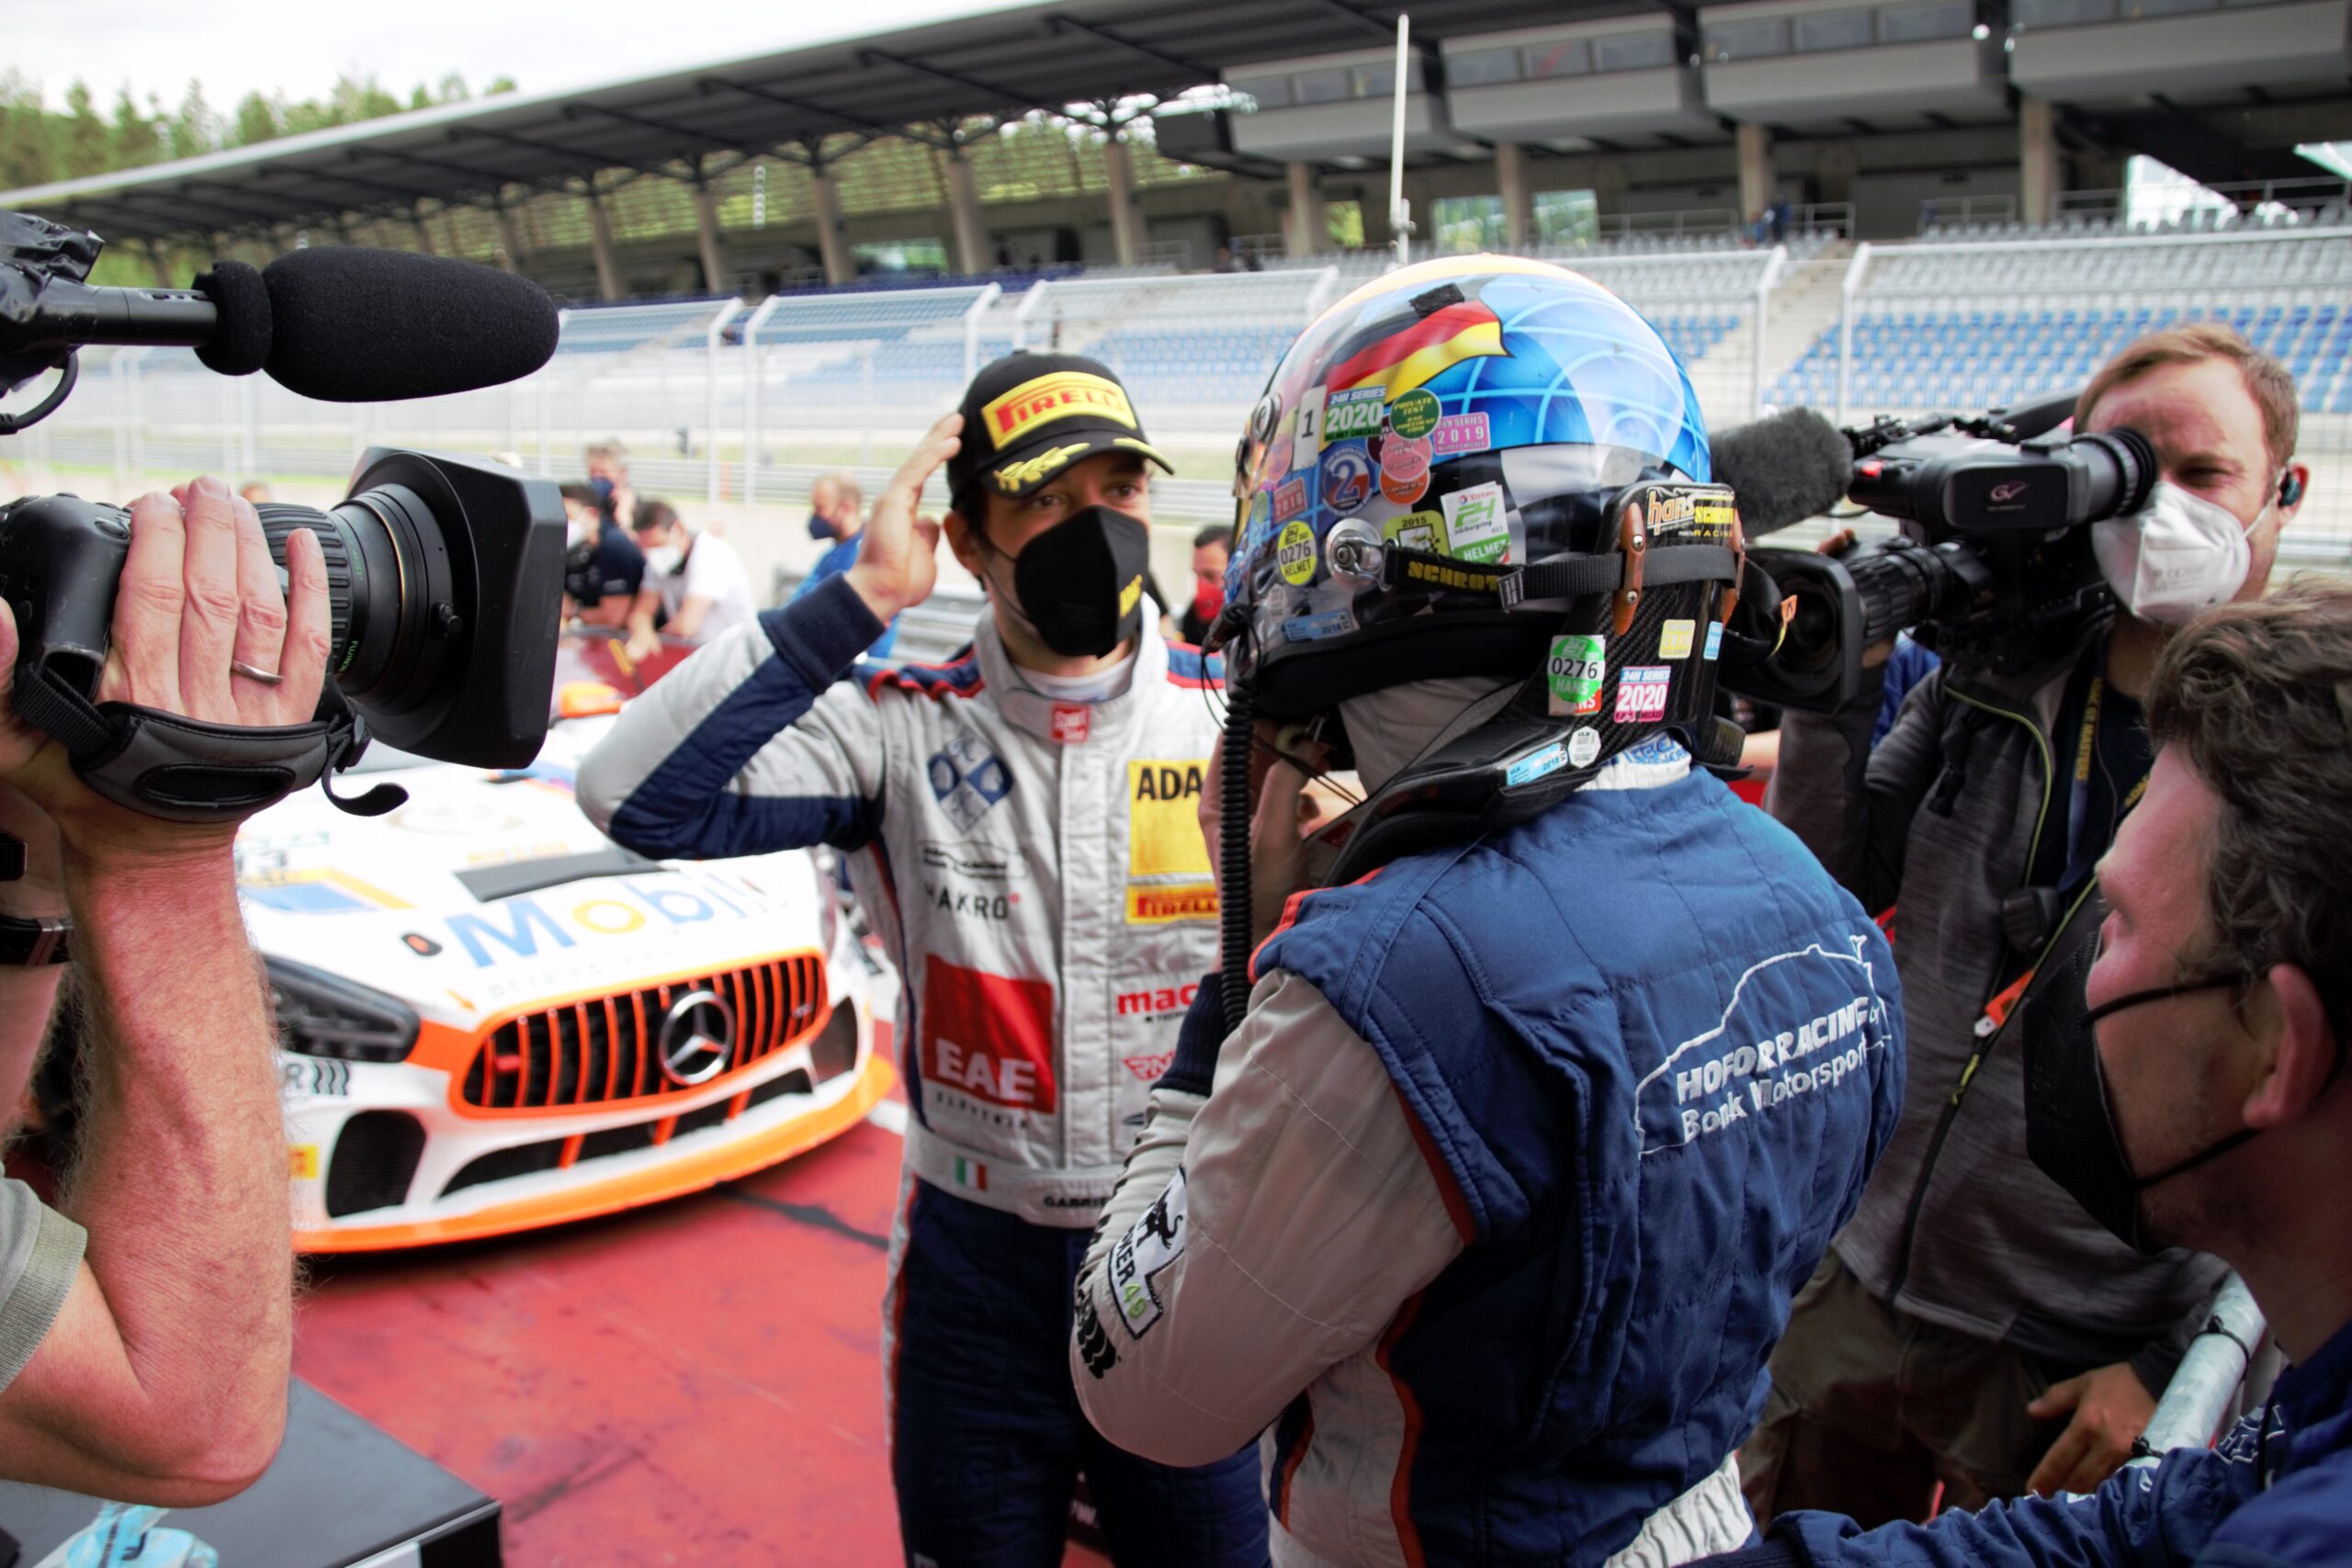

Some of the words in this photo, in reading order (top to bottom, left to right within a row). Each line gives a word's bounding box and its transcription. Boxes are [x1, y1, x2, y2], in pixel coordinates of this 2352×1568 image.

[1350, 387, 1386, 401] SERIES
[1394, 396, 1433, 411] PRIVATE
[1327, 401, 1384, 432] 2020
[1402, 405, 1425, 415] TEST
[1453, 415, 1484, 426] SERIES
[1301, 410, 1315, 439] 1
[1438, 425, 1485, 446] 2019
[1333, 458, 1360, 503] 2
[1401, 516, 1428, 527] 2015
[1647, 489, 1696, 536] hans
[1280, 541, 1312, 566] 0276
[1284, 559, 1312, 576] HELMET
[1551, 656, 1600, 680] 0276
[1643, 669, 1671, 682] SERIES
[1556, 677, 1589, 696] HANS
[1617, 683, 1668, 712] 2020
[935, 1037, 1036, 1103] EAE
